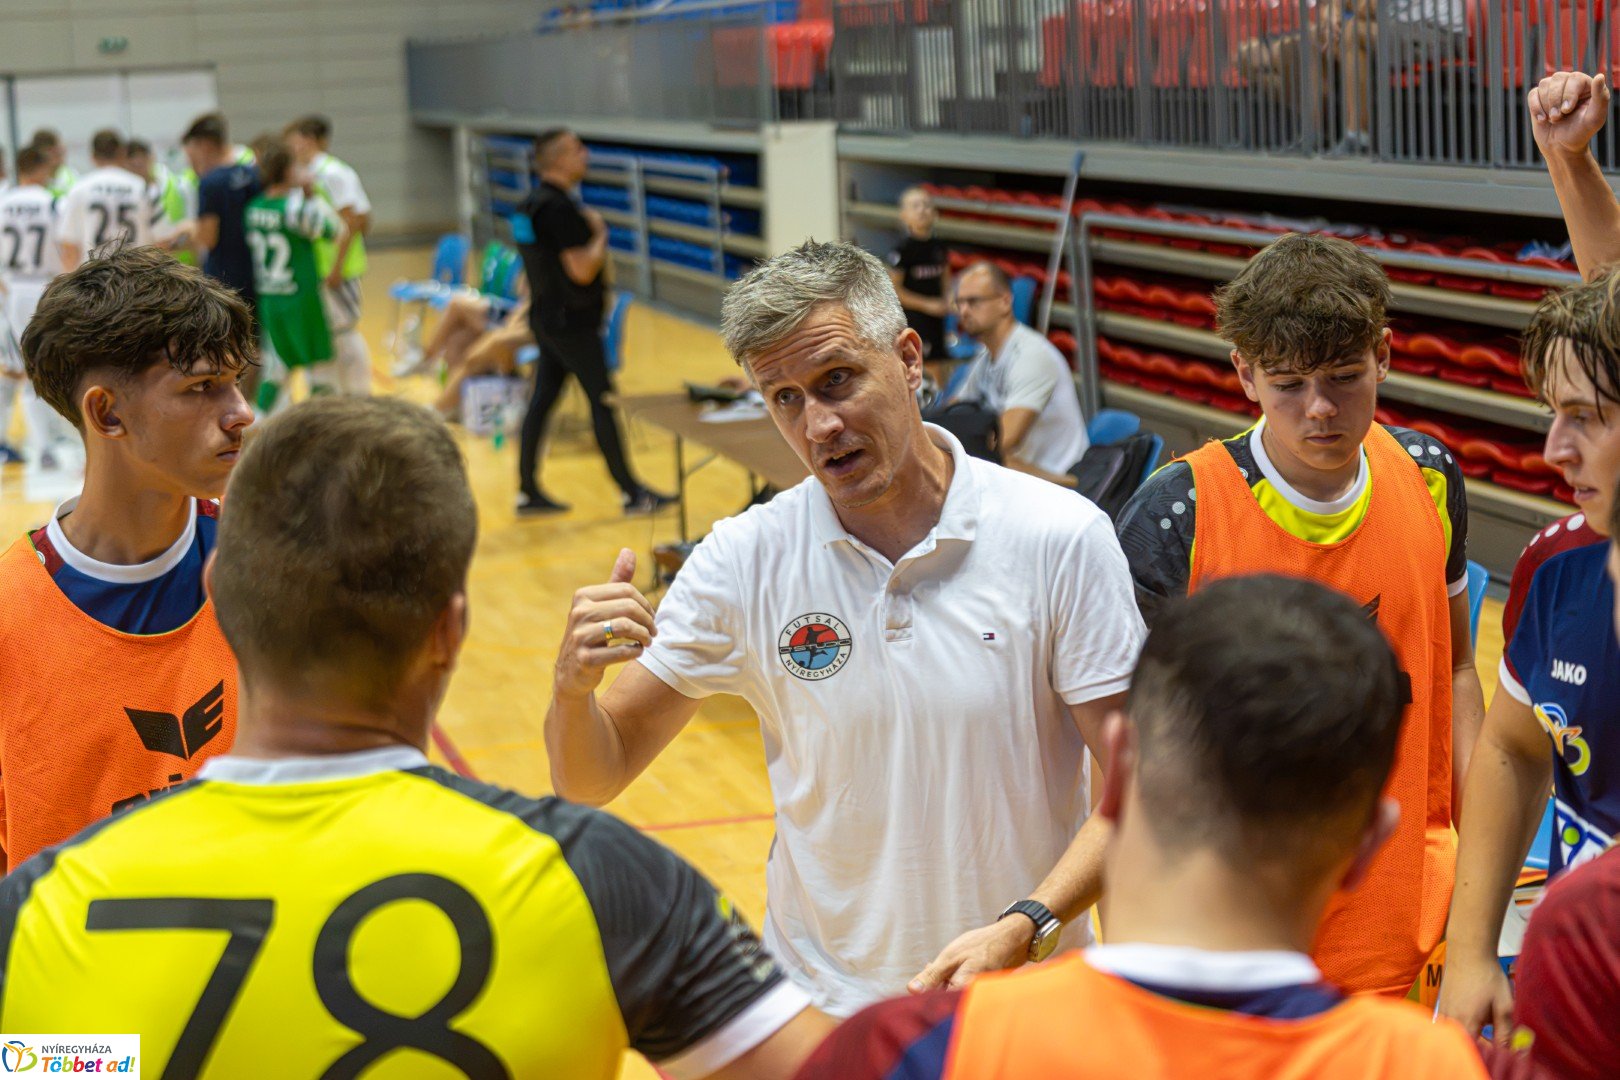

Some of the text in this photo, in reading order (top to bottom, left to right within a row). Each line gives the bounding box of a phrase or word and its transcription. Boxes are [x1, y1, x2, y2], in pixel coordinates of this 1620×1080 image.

[88, 203, 137, 246] 25
[3, 225, 46, 269] 27
[785, 615, 839, 637] FUTSAL
[785, 651, 848, 678] NYÍREGYHÁZA
[1551, 658, 1587, 686] JAKO
[85, 872, 515, 1080] 78
